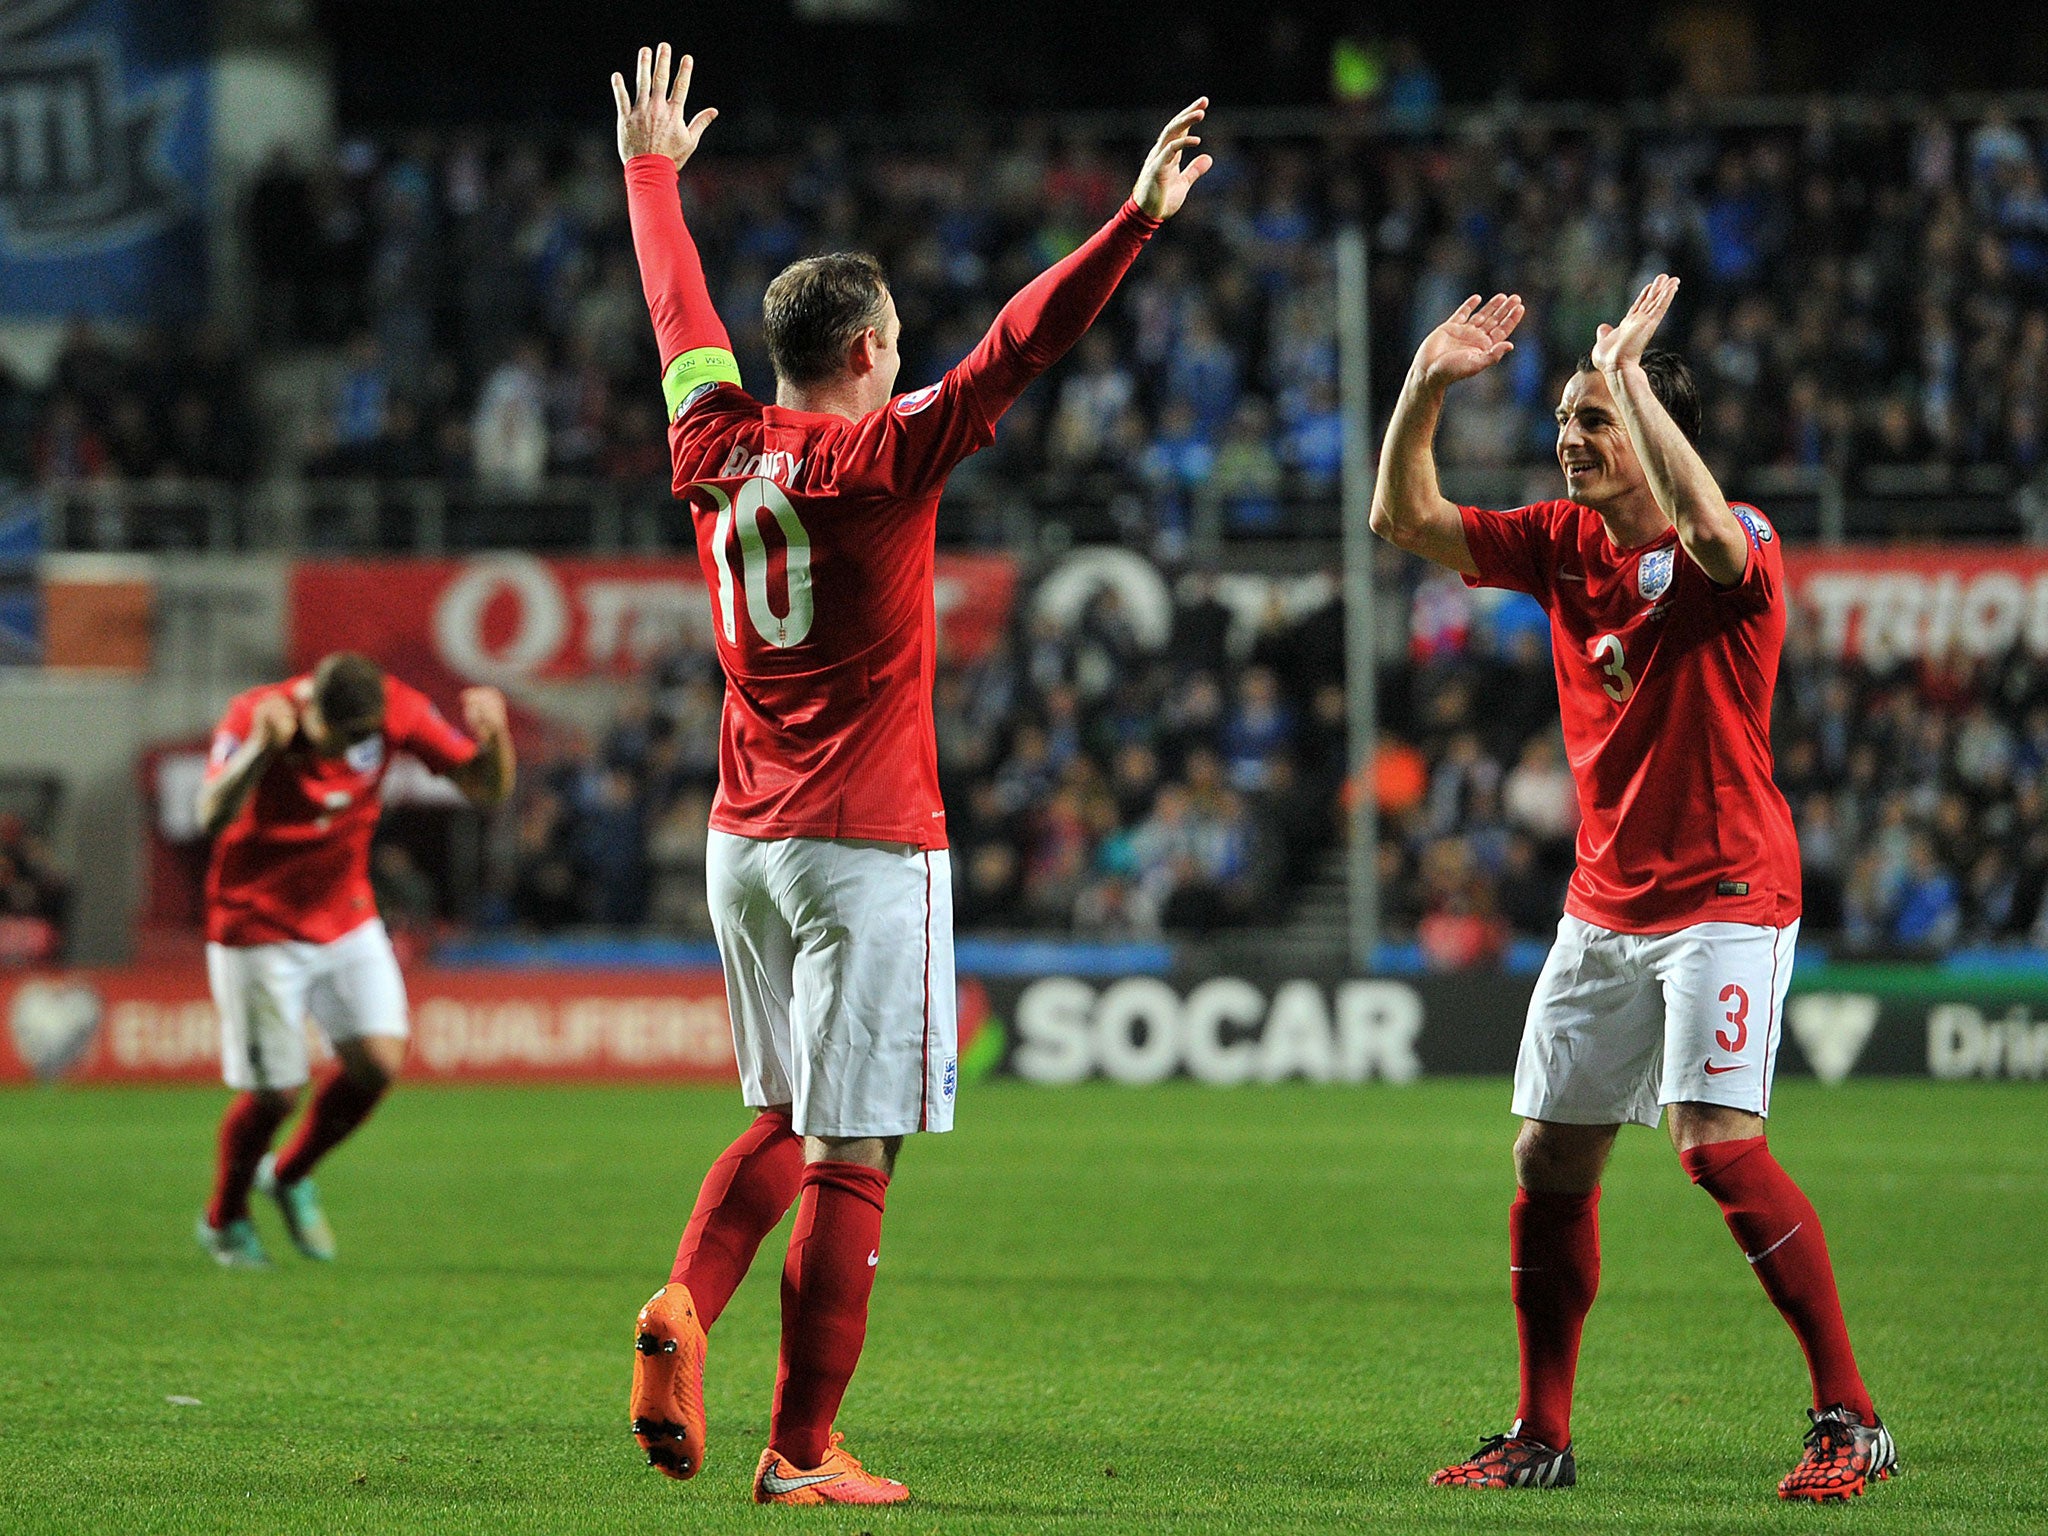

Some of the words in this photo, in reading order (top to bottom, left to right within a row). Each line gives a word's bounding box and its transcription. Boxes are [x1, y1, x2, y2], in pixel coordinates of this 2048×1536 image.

[690, 476, 814, 648] 10
[1594, 633, 1634, 702] 3
[1015, 977, 1423, 1084] SOCAR
[1715, 983, 1749, 1053] 3
